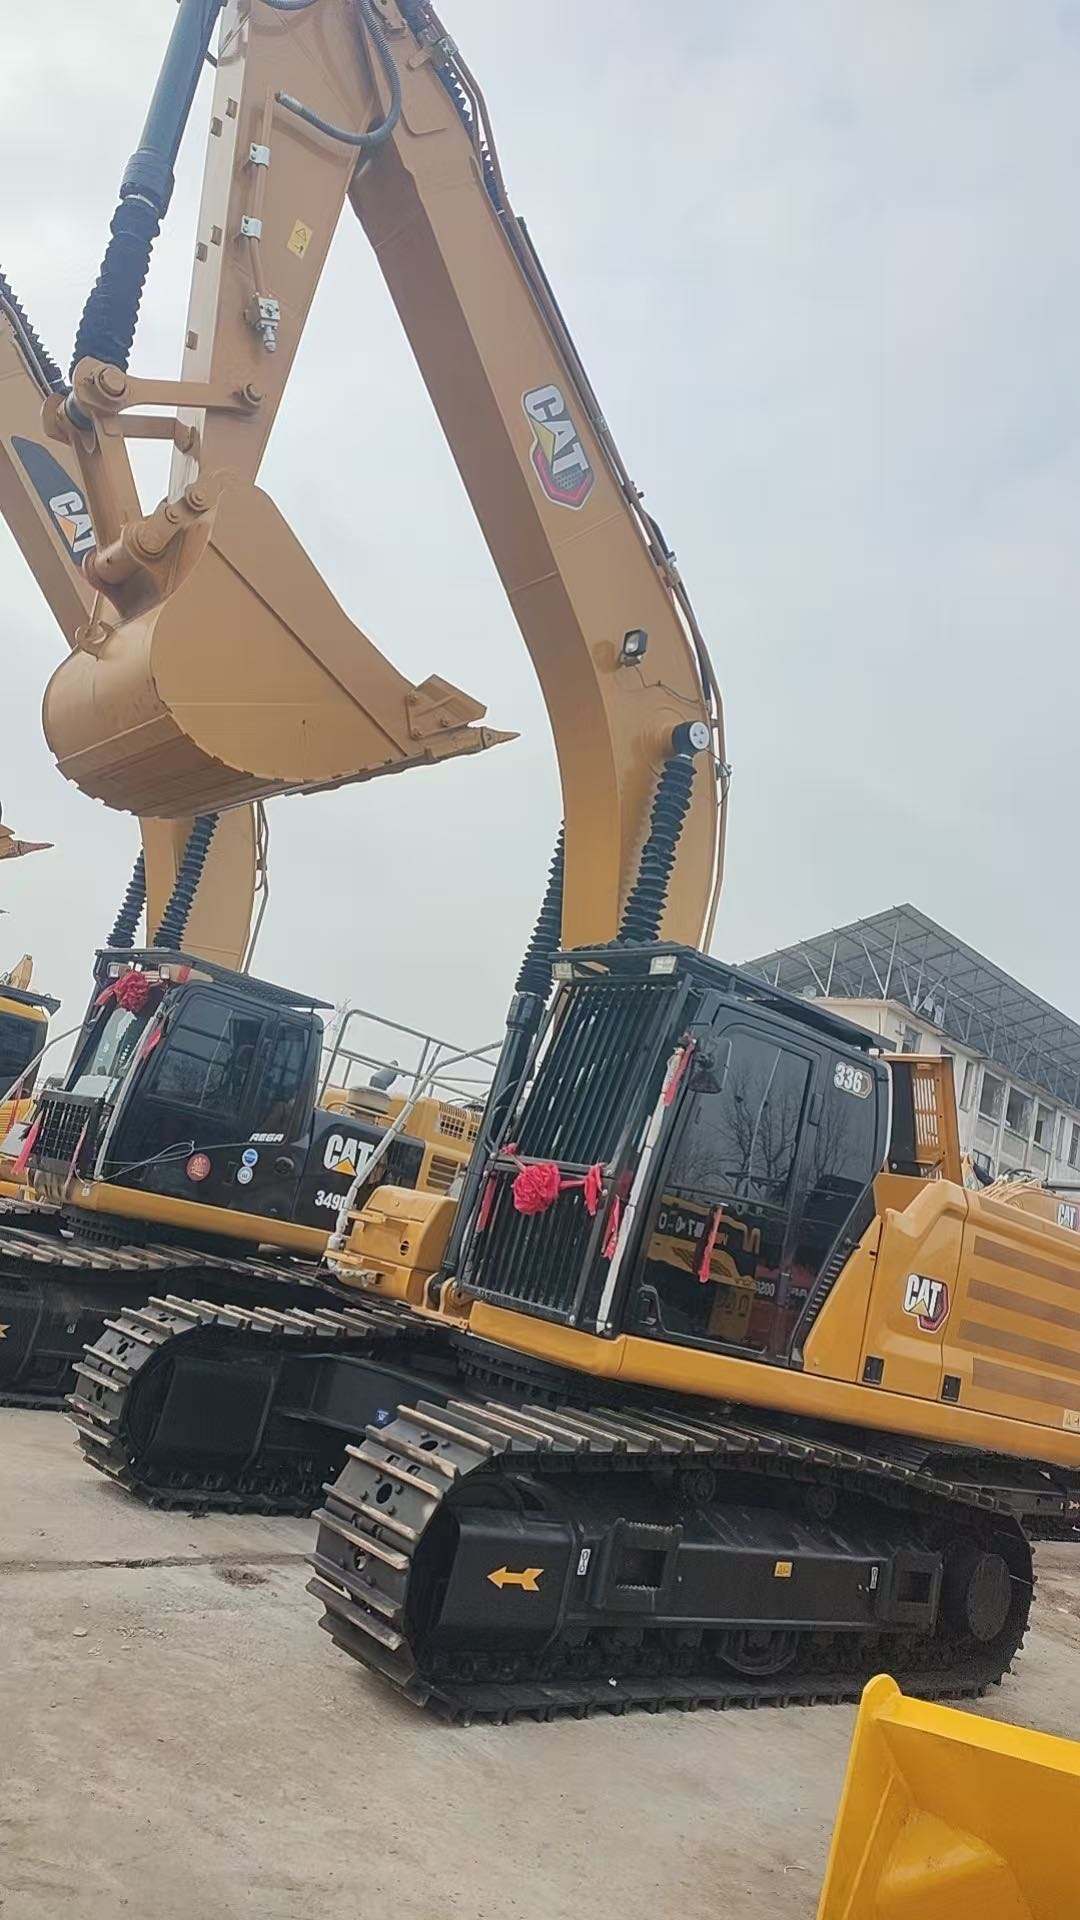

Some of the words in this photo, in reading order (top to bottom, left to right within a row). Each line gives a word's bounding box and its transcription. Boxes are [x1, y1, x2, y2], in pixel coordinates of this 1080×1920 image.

[524, 385, 589, 474] CAT
[49, 491, 97, 553] CAT
[834, 1062, 863, 1093] 336
[323, 1134, 375, 1178] CAT
[1057, 1203, 1076, 1229] CAT
[904, 1274, 943, 1318] CAT
